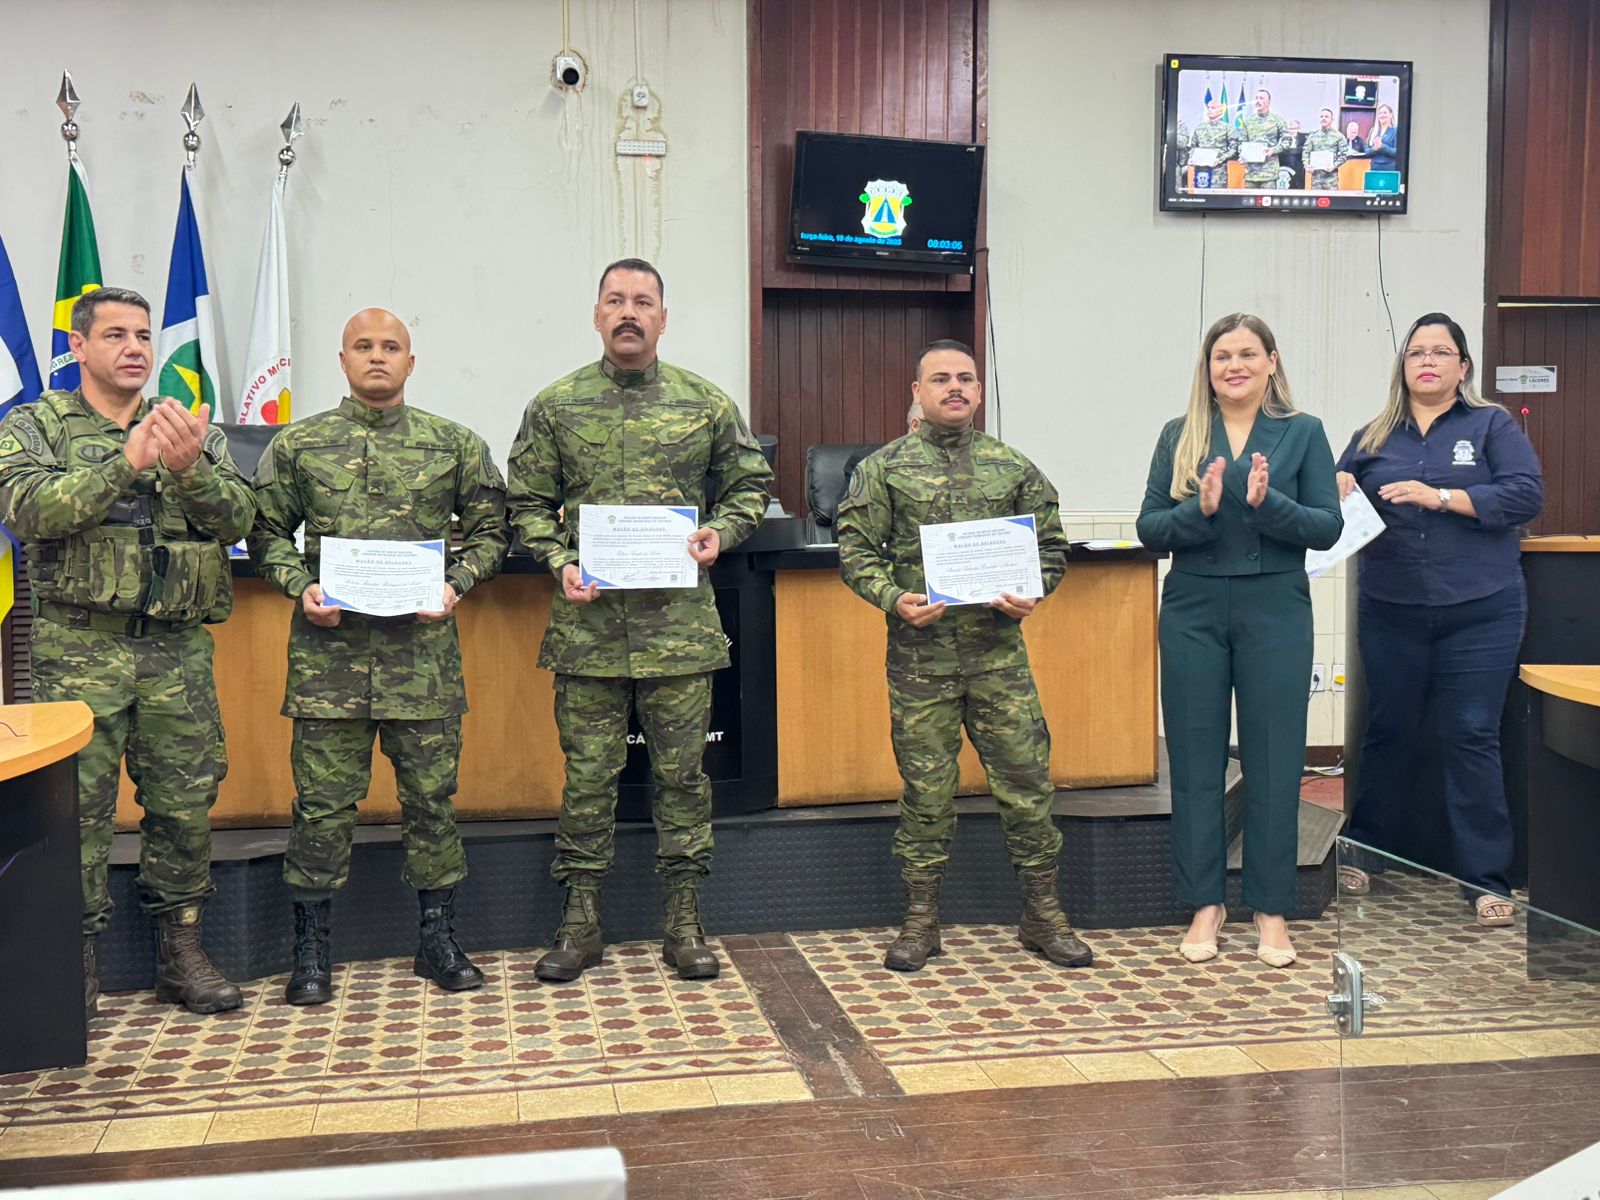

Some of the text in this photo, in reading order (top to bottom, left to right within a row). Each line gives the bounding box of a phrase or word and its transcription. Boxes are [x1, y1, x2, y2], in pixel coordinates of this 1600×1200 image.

[800, 232, 834, 243] terça-feira,
[854, 237, 875, 245] agosto
[886, 238, 902, 246] 2025
[927, 239, 963, 250] 08:03:05
